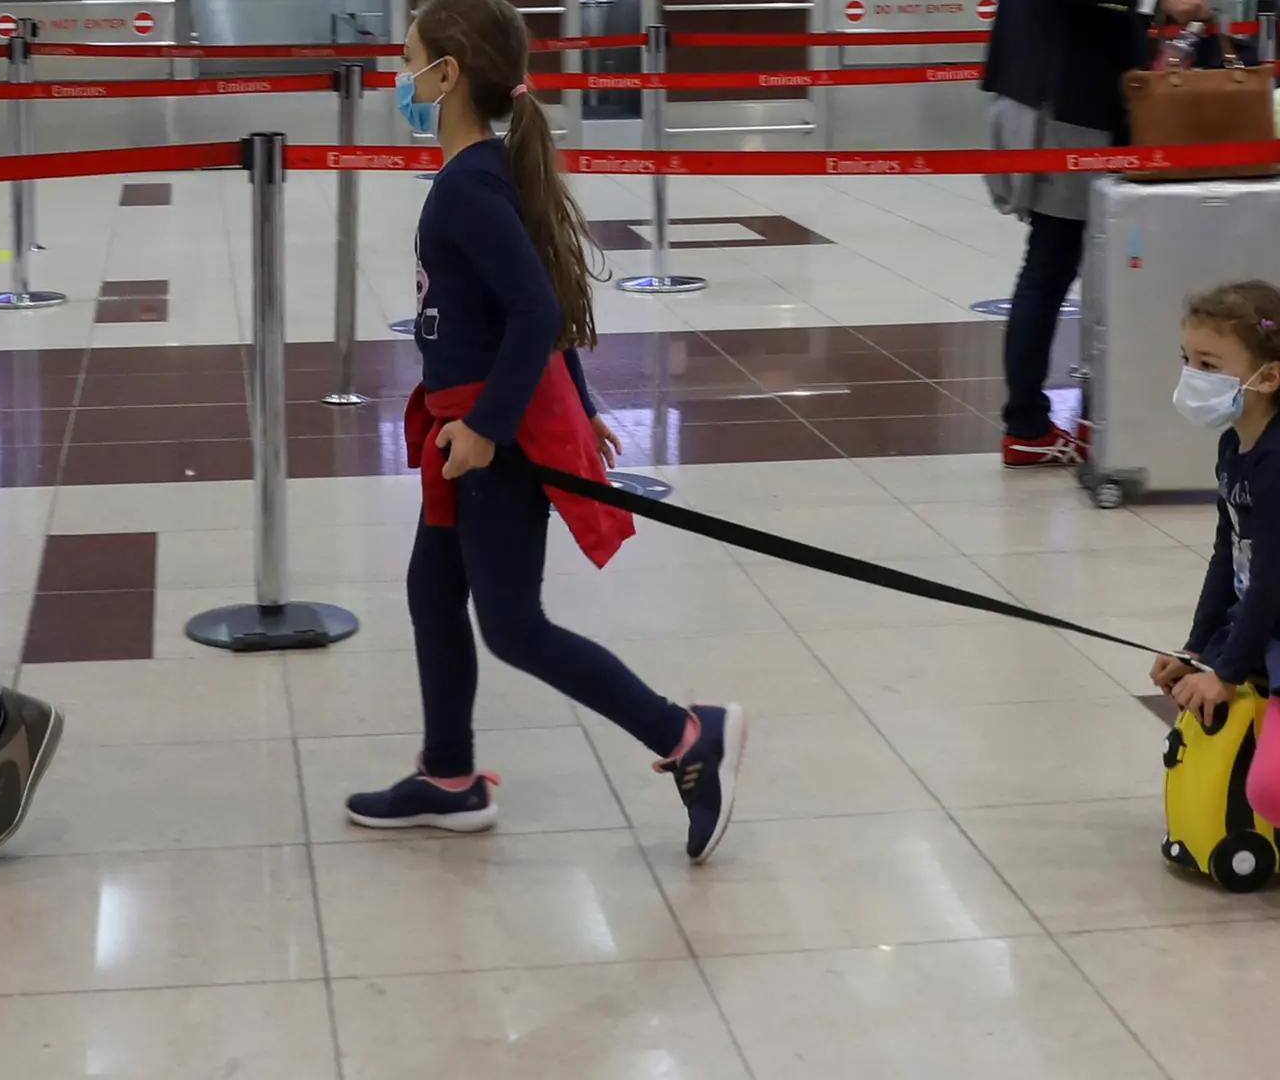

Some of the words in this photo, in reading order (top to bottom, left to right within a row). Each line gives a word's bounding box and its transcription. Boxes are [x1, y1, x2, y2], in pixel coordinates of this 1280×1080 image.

[875, 4, 892, 14] DO
[897, 4, 921, 14] NOT
[926, 3, 964, 13] ENTER
[51, 19, 78, 29] NOT
[83, 18, 127, 29] ENTER
[758, 74, 813, 87] Emirates
[926, 66, 980, 81] Emirates
[217, 80, 272, 94] Emirates
[588, 75, 642, 89] Emirates
[51, 84, 107, 98] Emirates
[327, 149, 405, 170] Emirates
[579, 154, 656, 173] Emirates
[825, 155, 901, 173] Emirates
[1066, 152, 1141, 170] Emirates
